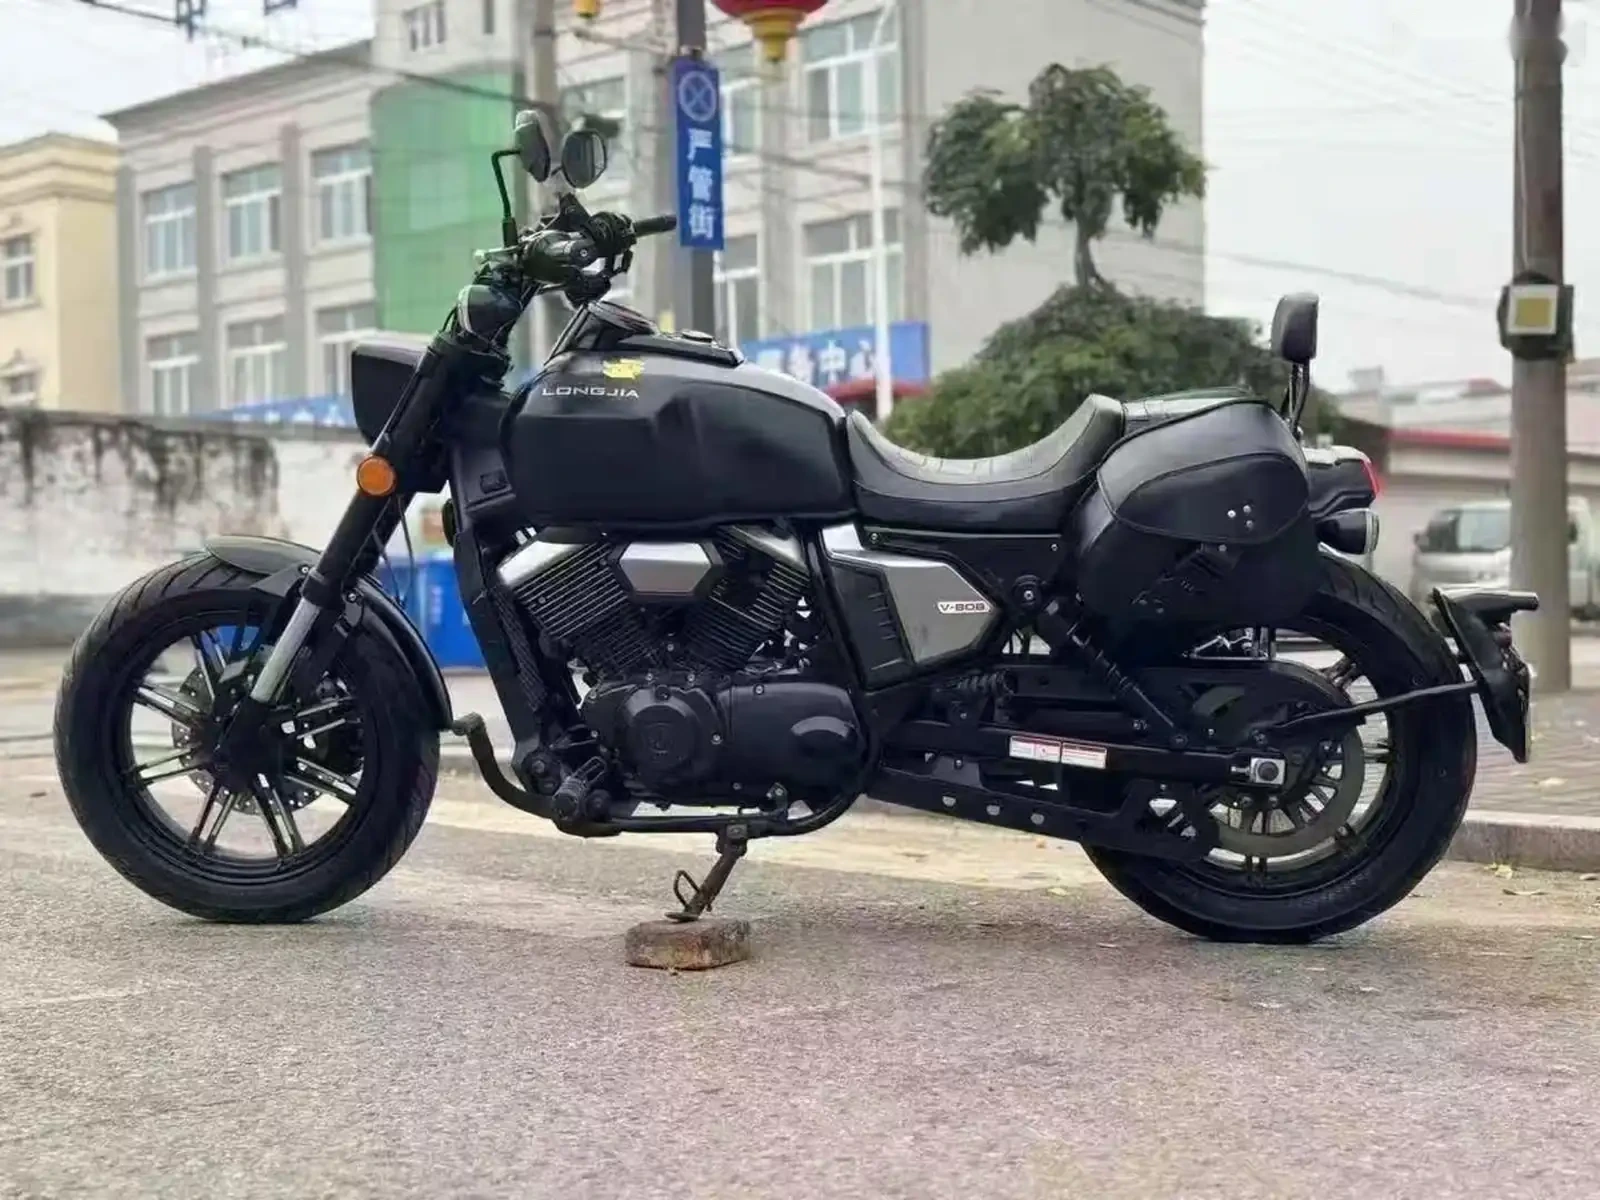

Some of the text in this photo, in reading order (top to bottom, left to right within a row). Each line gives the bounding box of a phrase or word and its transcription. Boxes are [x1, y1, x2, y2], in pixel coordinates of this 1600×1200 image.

[687, 127, 714, 239] 严管街
[541, 386, 640, 399] LONGJIA
